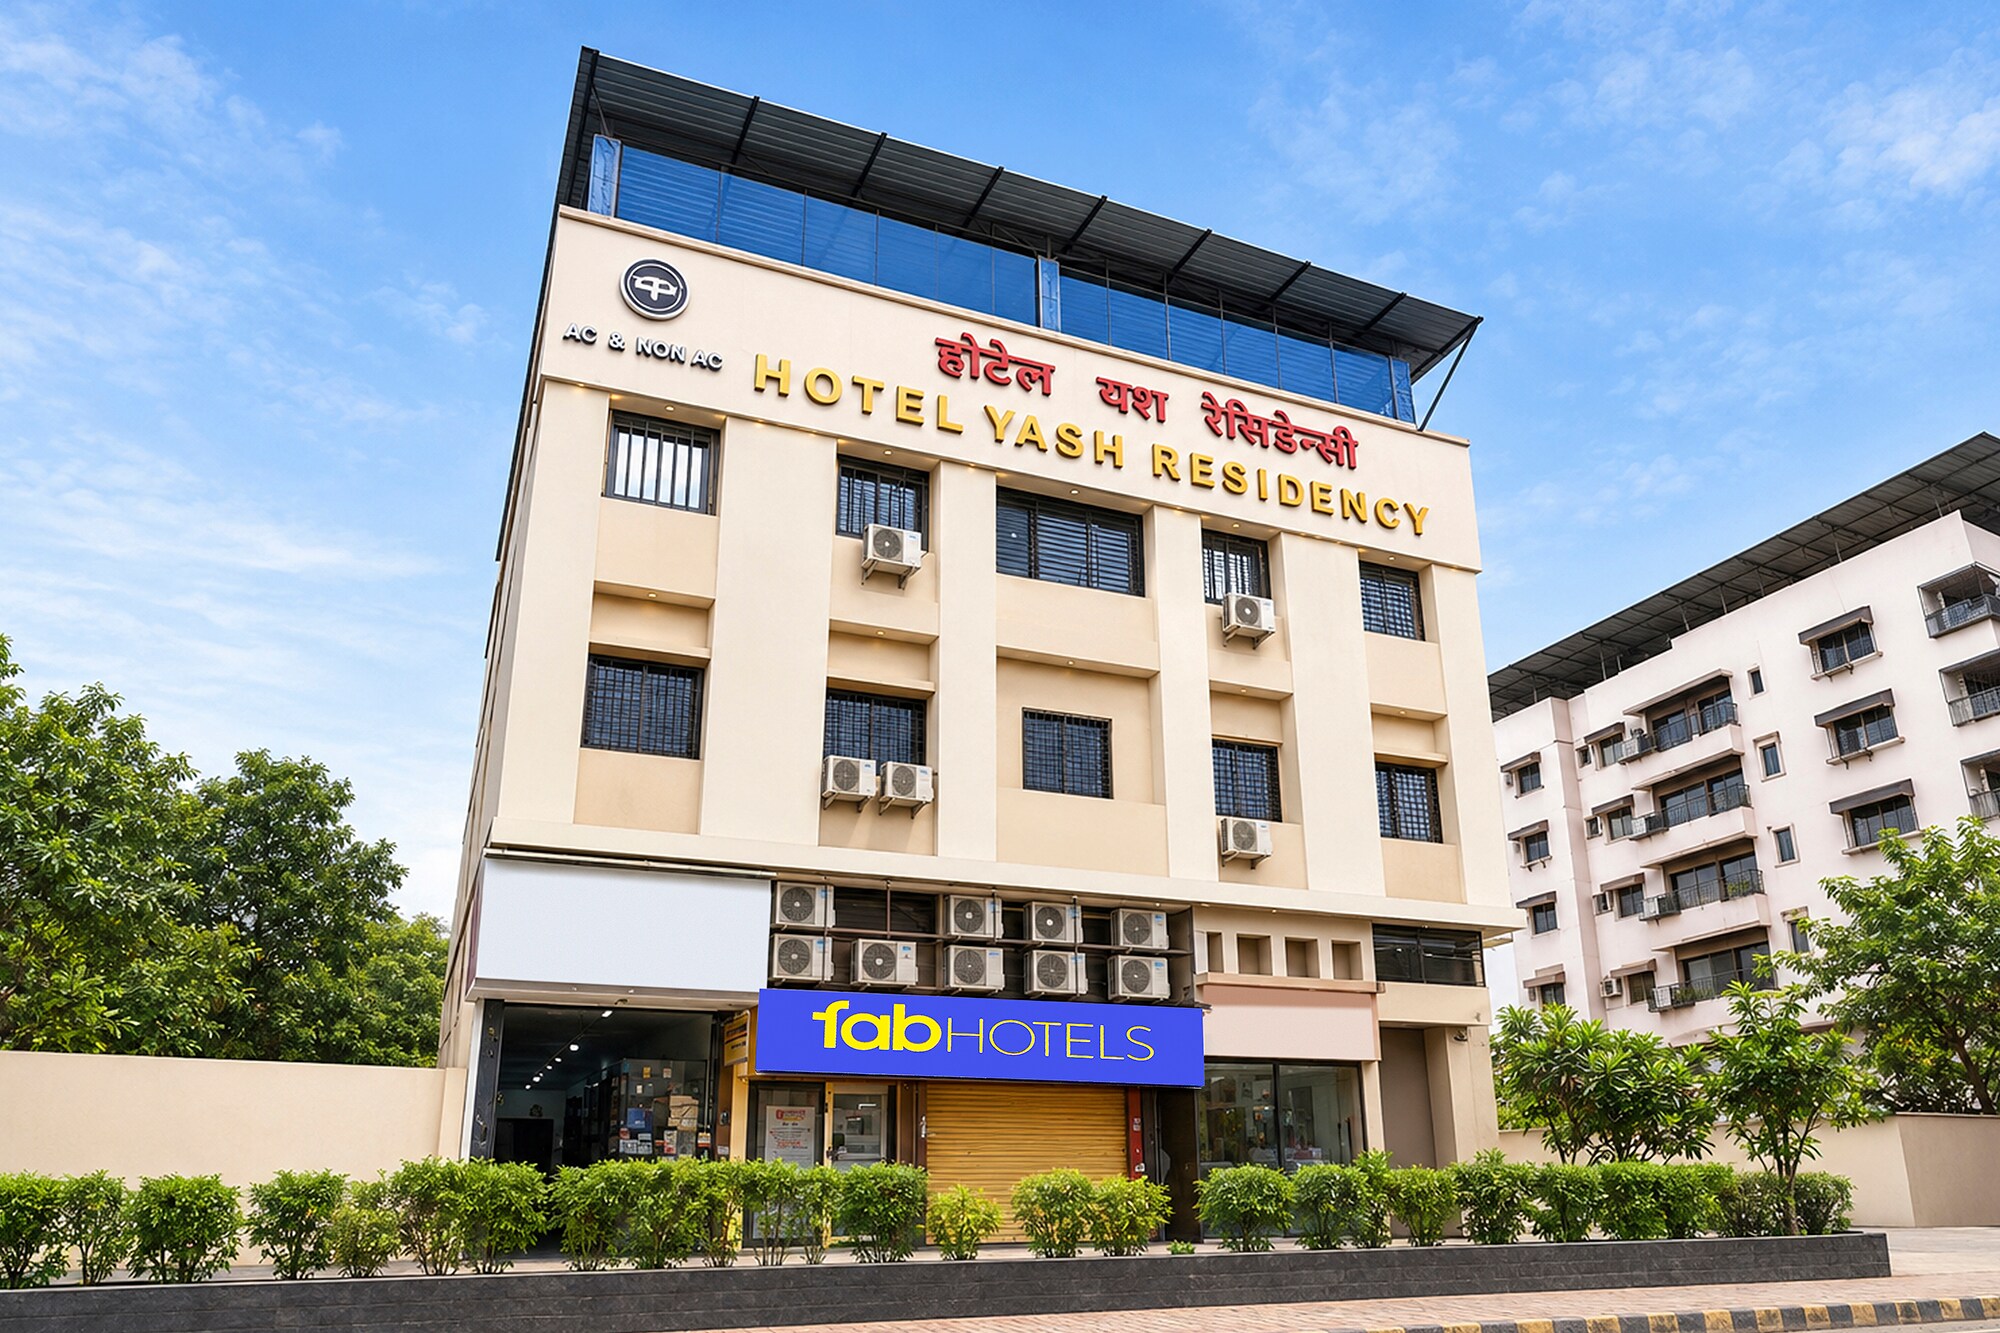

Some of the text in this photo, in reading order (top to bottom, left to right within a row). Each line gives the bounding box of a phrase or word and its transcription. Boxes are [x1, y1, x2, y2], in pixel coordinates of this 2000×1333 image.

[562, 323, 723, 372] AC & NON AC
[935, 332, 1359, 470] होटेल यश रेसिडेन्सी
[754, 354, 1430, 536] HOTEL YASH RESIDENCY
